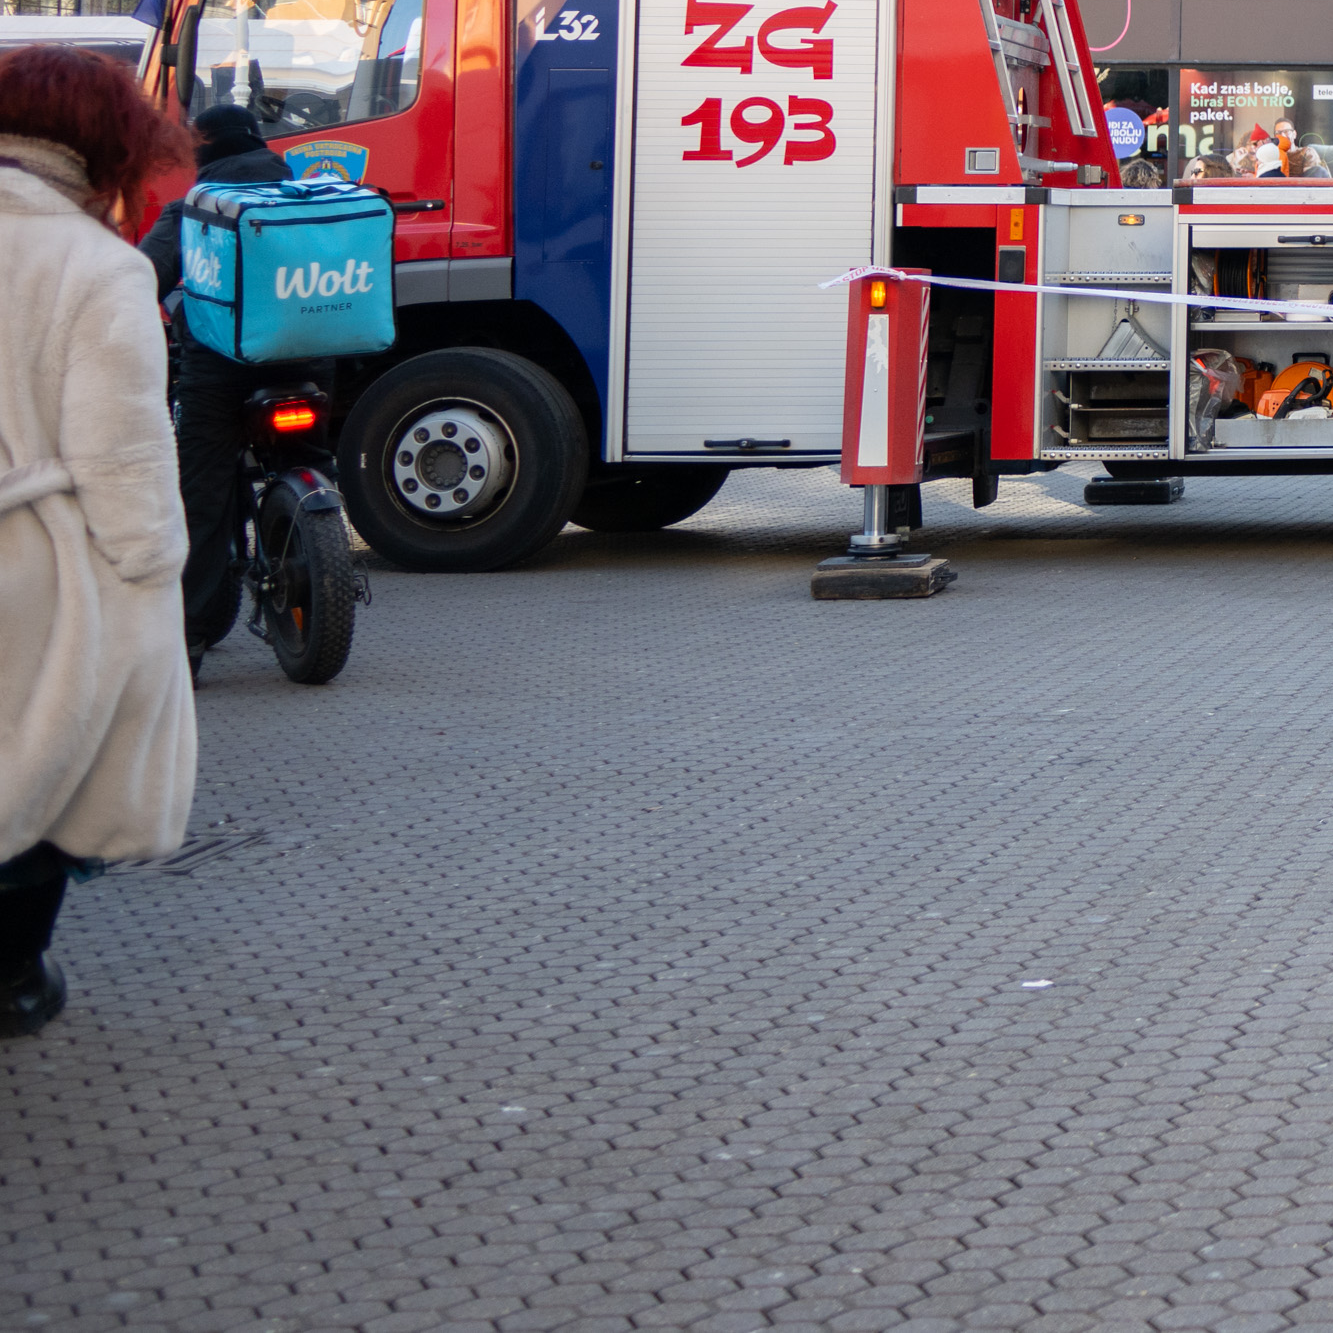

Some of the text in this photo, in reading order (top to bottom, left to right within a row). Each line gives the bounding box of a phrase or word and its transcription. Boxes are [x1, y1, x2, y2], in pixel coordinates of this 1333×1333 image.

[535, 6, 600, 41] L32
[1190, 82, 1293, 97] Kad znaš bolje,
[1190, 96, 1295, 108] biraš EON TRIO
[1190, 109, 1233, 123] paket.
[680, 94, 837, 168] 193
[1122, 121, 1134, 129] ZA
[275, 258, 374, 299] Wolt
[301, 303, 352, 315] PARTNER
